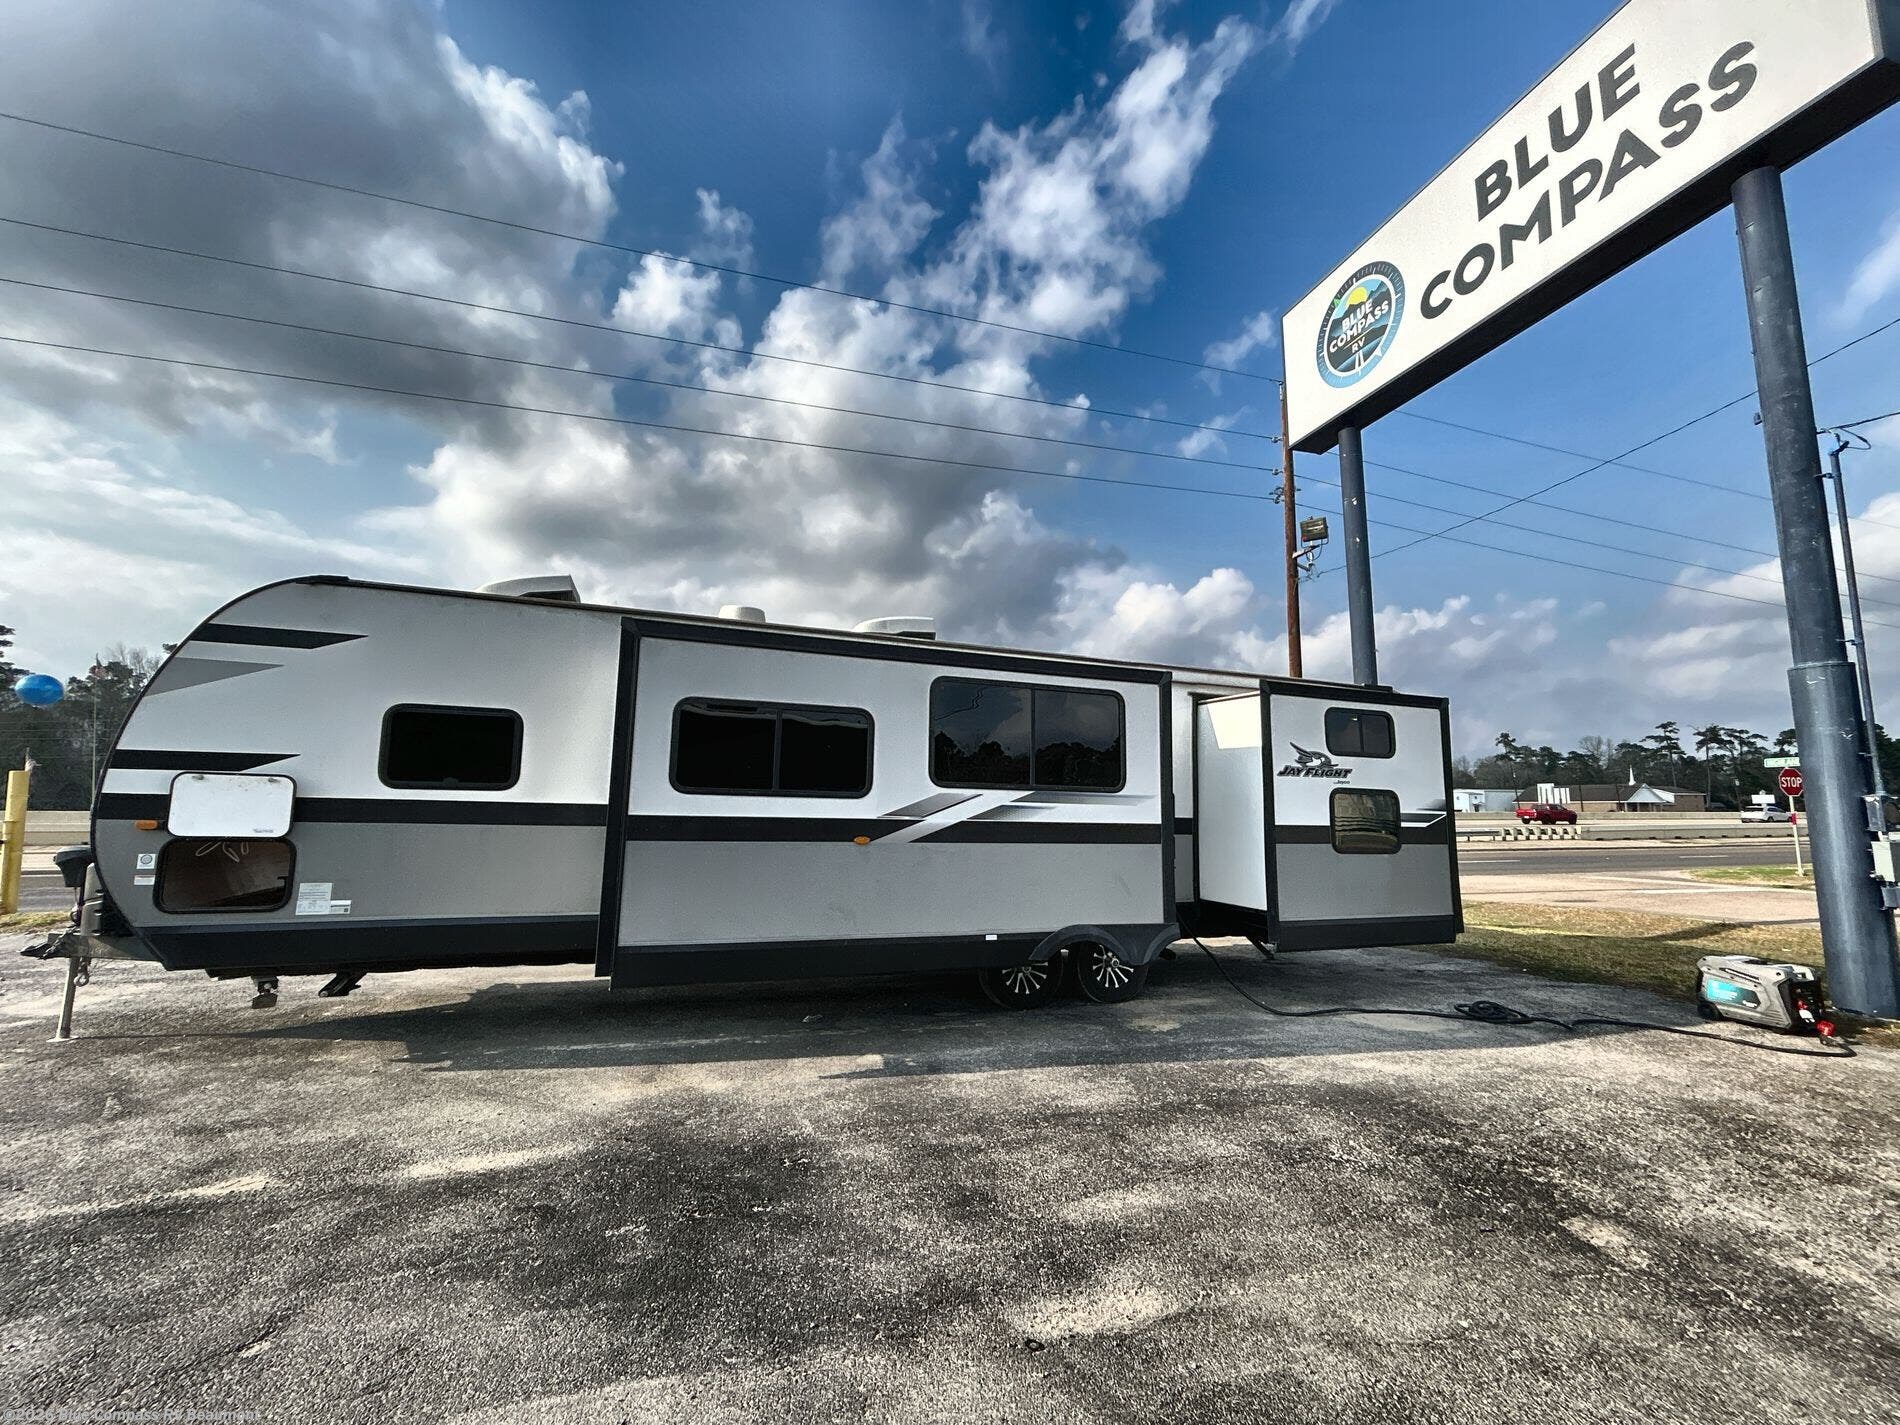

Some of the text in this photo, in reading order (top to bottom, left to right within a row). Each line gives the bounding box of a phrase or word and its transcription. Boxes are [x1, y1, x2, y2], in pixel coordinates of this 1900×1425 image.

[1474, 42, 1640, 221] BLUE
[1420, 41, 1757, 319] COMPASS
[1329, 300, 1389, 353] COMPASS
[1341, 298, 1373, 331] BLUE
[1351, 337, 1366, 353] RV
[1277, 765, 1353, 778] JAY FLIGHT
[1781, 776, 1802, 787] STOP
